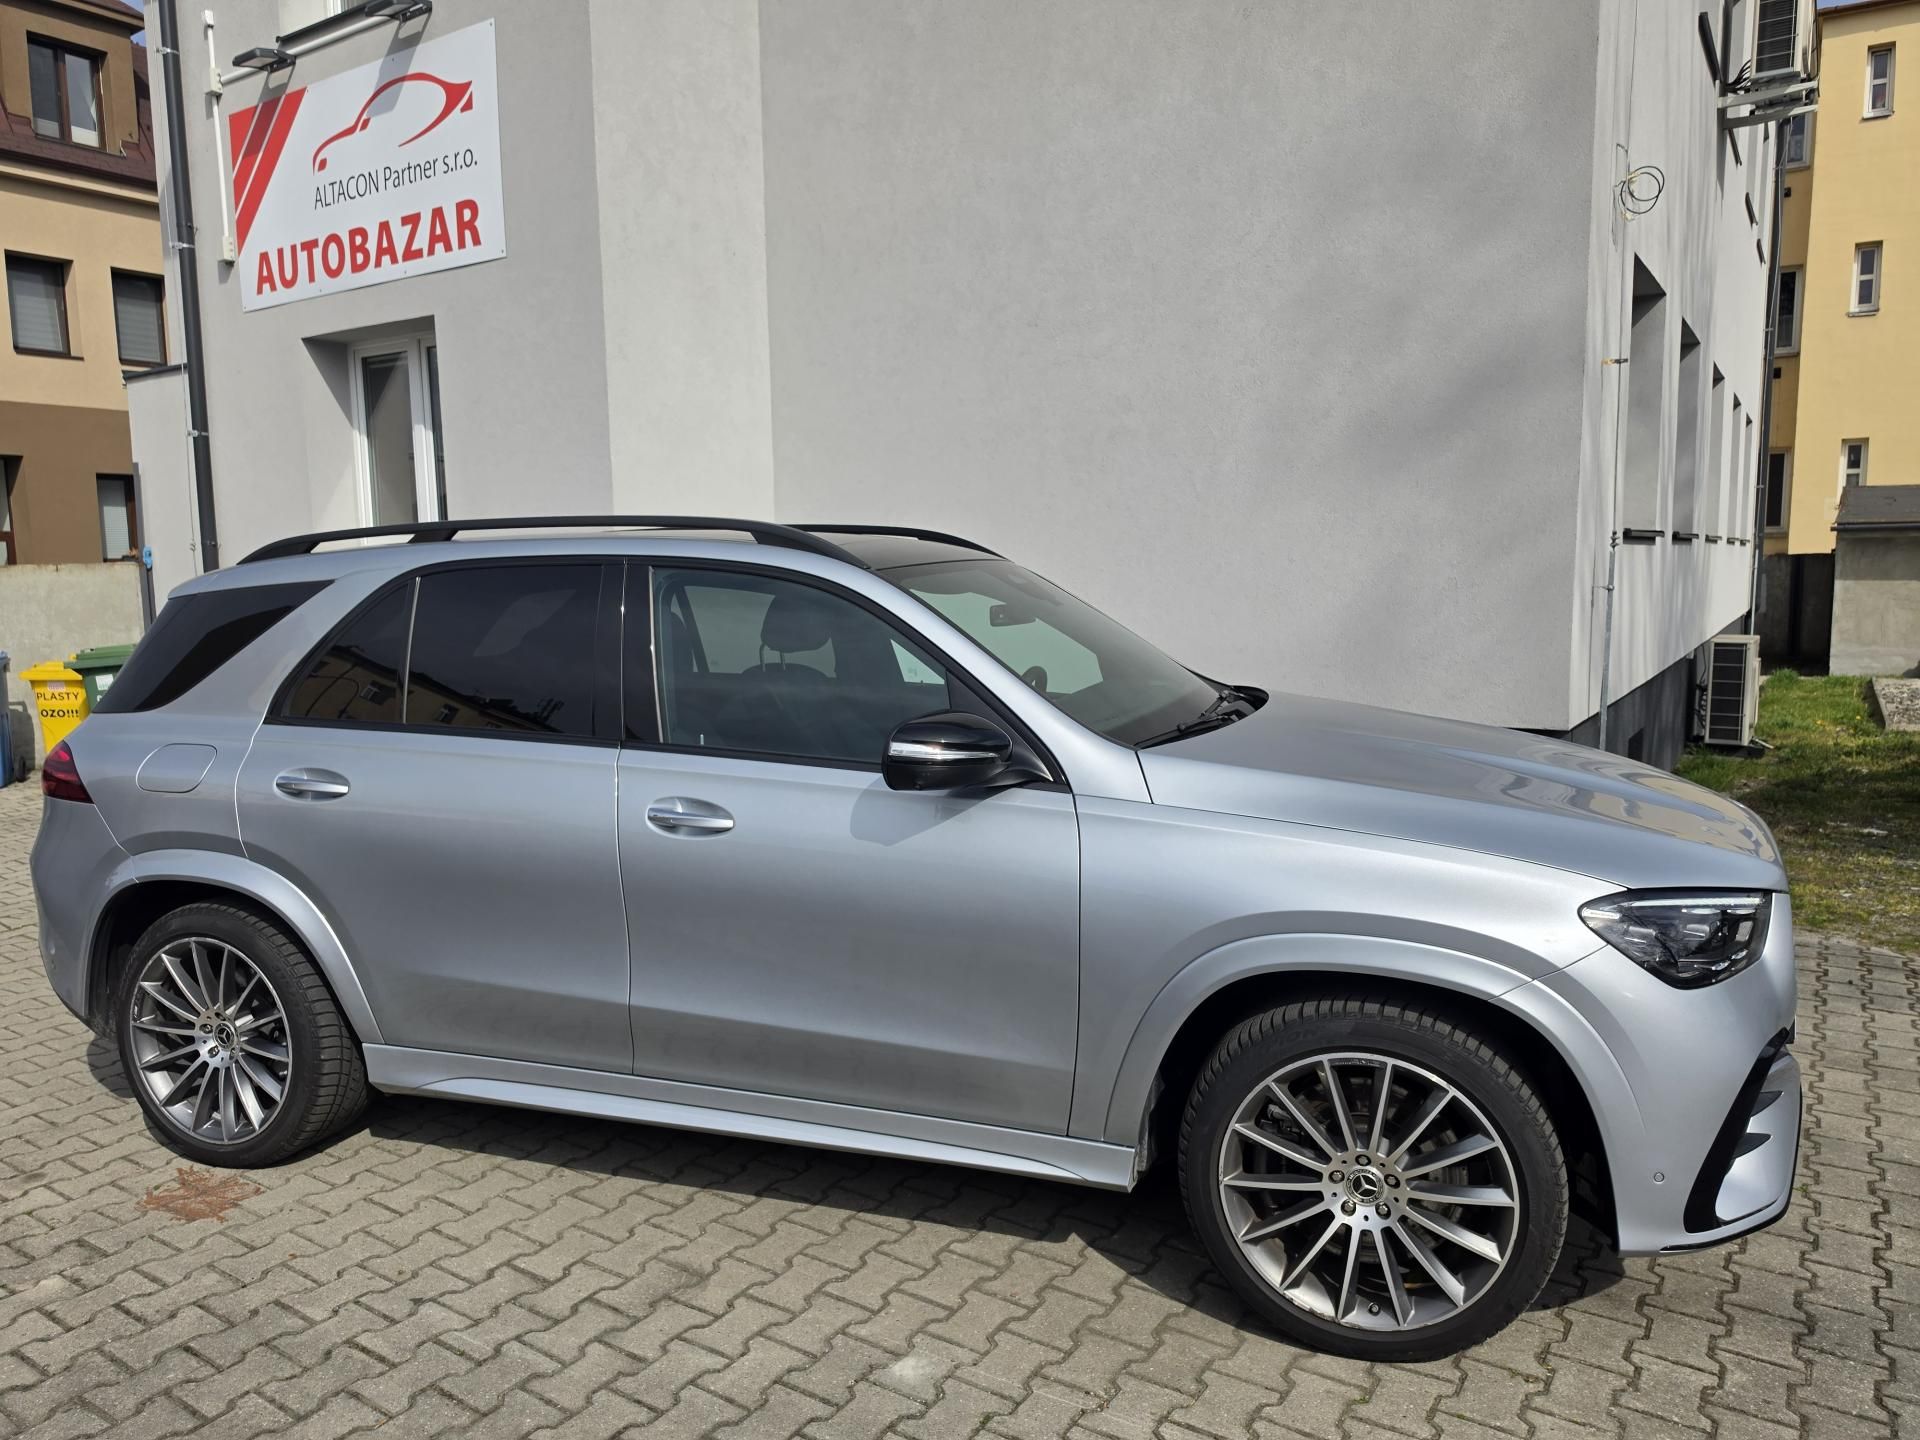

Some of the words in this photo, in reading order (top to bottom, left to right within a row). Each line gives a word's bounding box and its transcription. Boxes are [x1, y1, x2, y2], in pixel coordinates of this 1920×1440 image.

[314, 170, 379, 210] ALTACON
[384, 158, 438, 191] Partner
[443, 148, 478, 174] s.r.o.
[257, 199, 482, 296] AUTOBAZAR
[36, 692, 79, 701] PLASTY
[40, 709, 79, 718] OZO!!!
